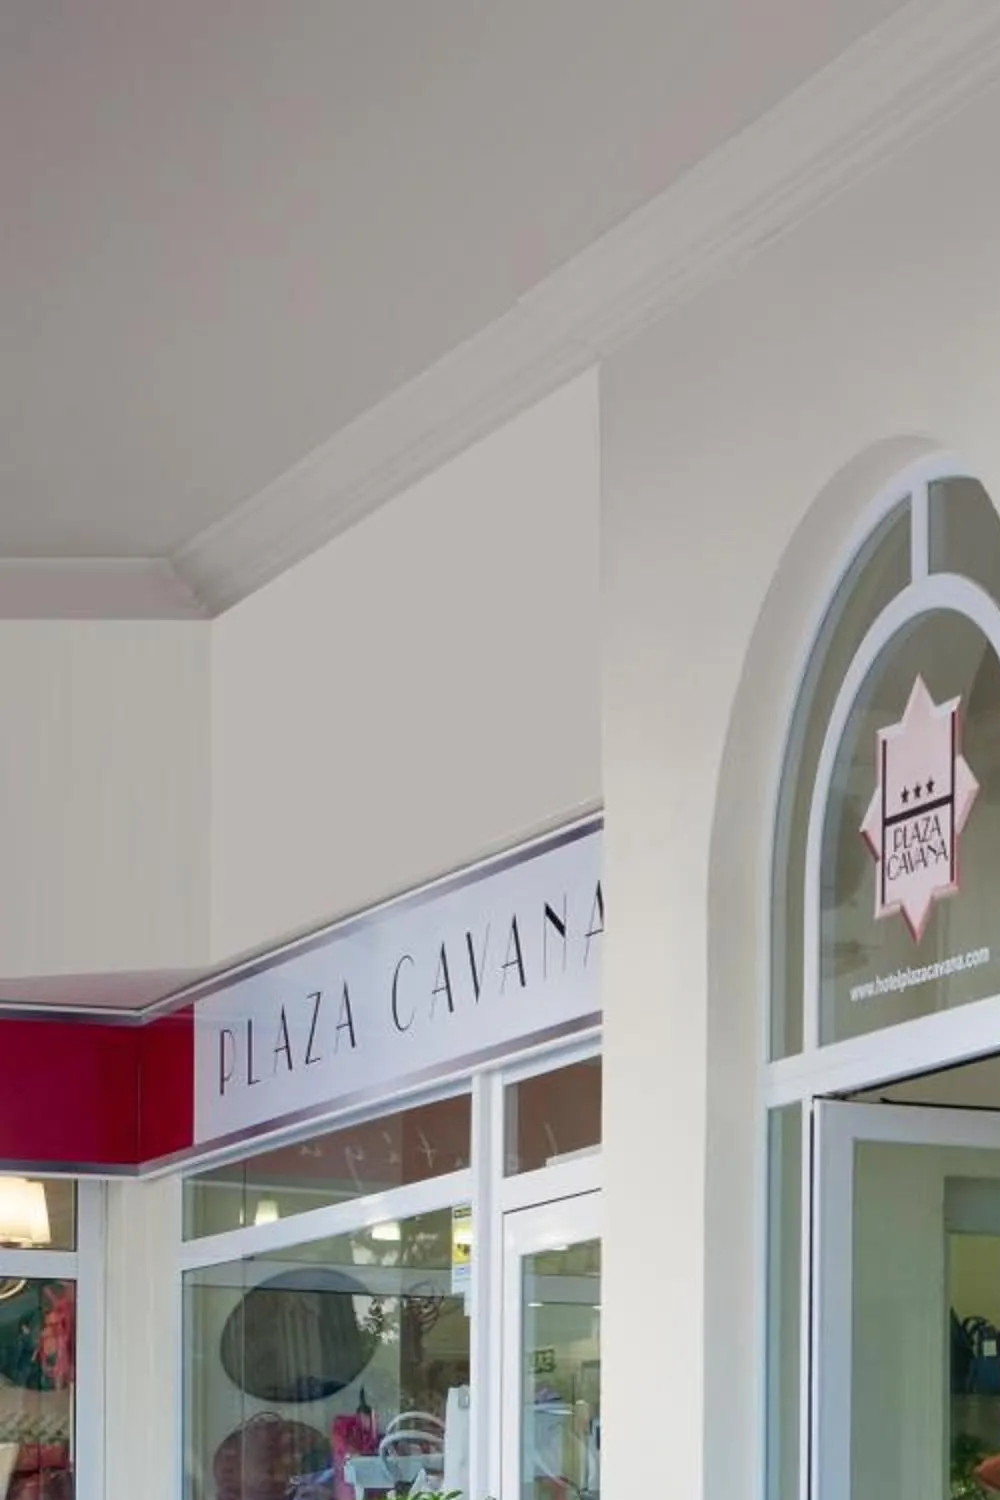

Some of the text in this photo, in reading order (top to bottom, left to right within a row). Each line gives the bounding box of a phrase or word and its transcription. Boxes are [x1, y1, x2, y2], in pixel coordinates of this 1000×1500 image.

[893, 814, 942, 852] PLAZA
[887, 839, 949, 881] CAVANA
[219, 879, 604, 1097] PLAZA CAVANA
